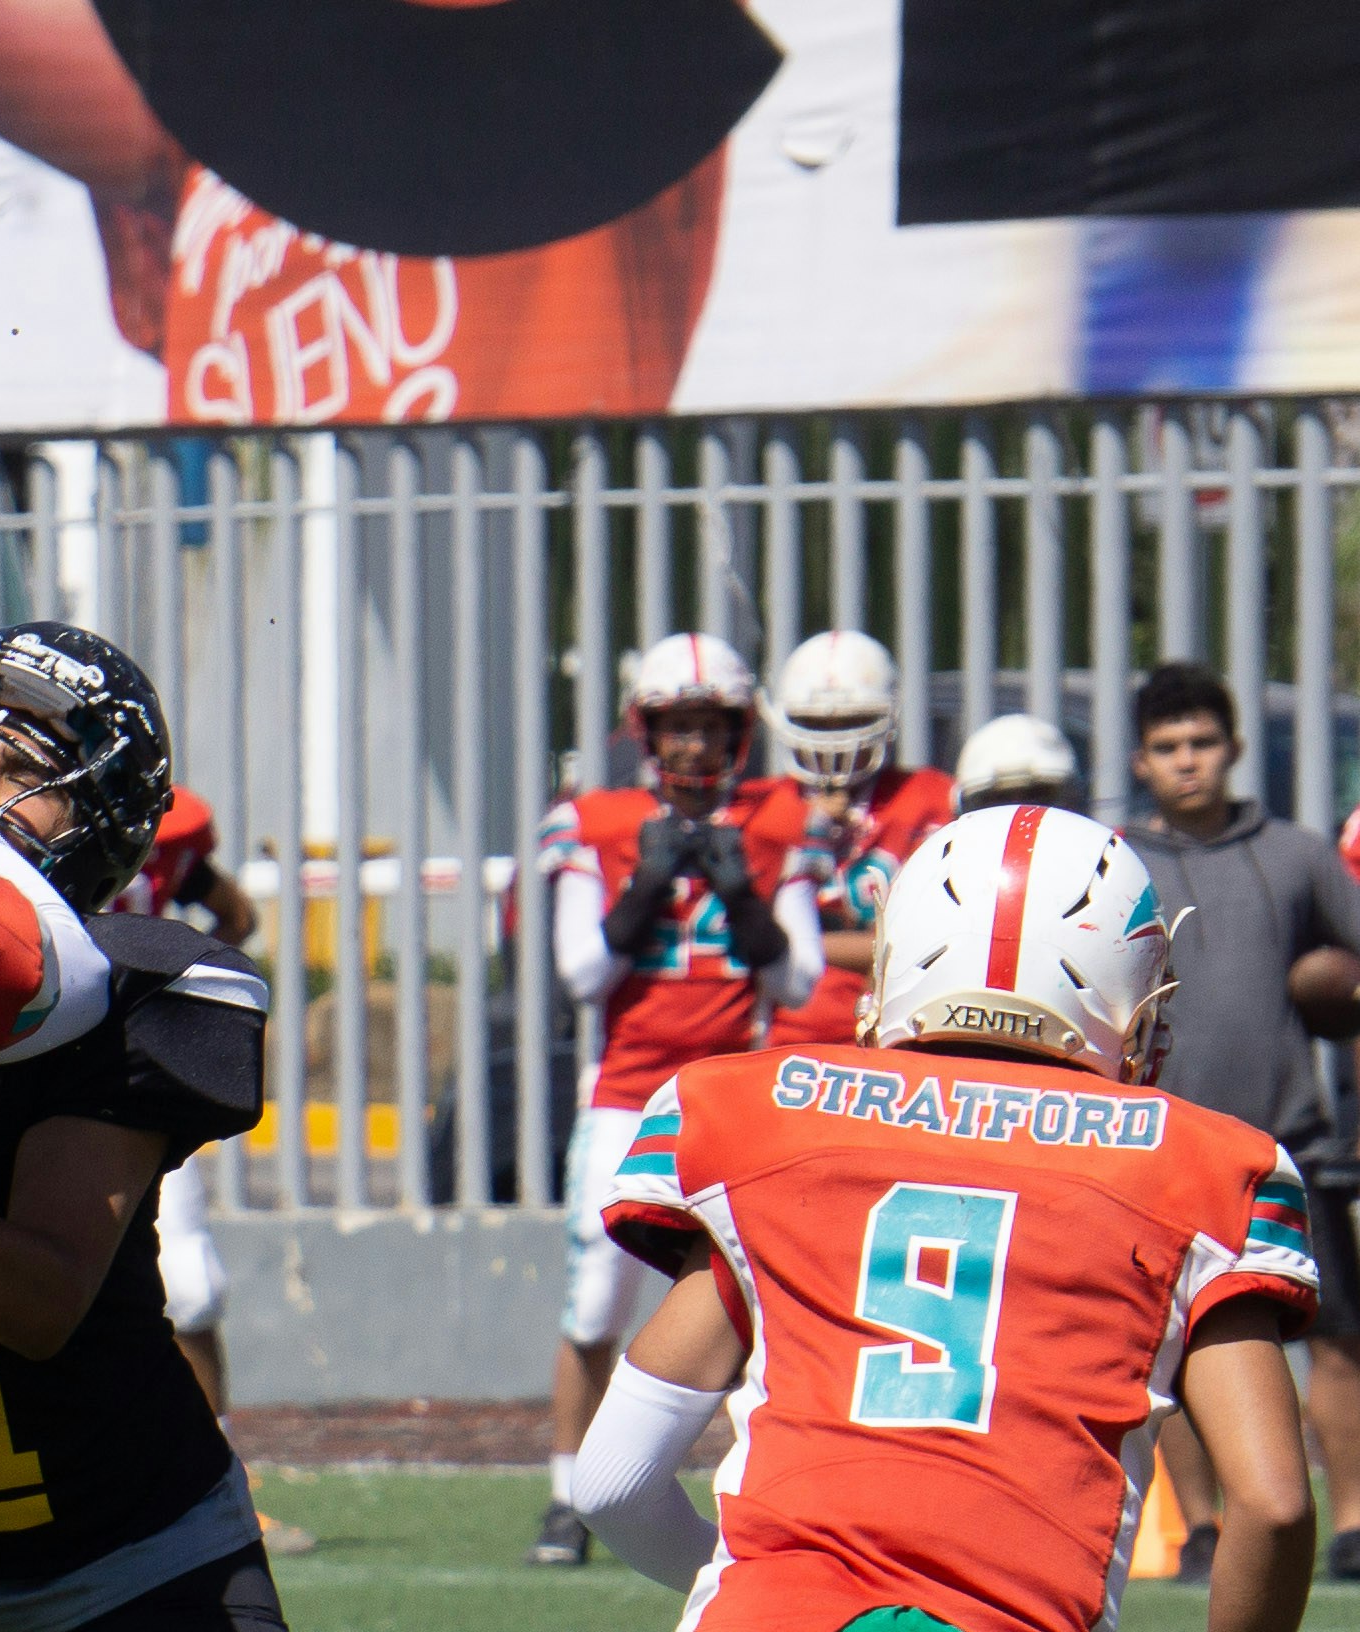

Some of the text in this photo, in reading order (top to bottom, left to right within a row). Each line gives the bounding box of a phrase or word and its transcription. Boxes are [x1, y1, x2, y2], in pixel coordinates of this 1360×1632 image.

[941, 1002, 1046, 1037] XENITH
[772, 1055, 1168, 1151] STRATFORD
[849, 1181, 1019, 1434] 9
